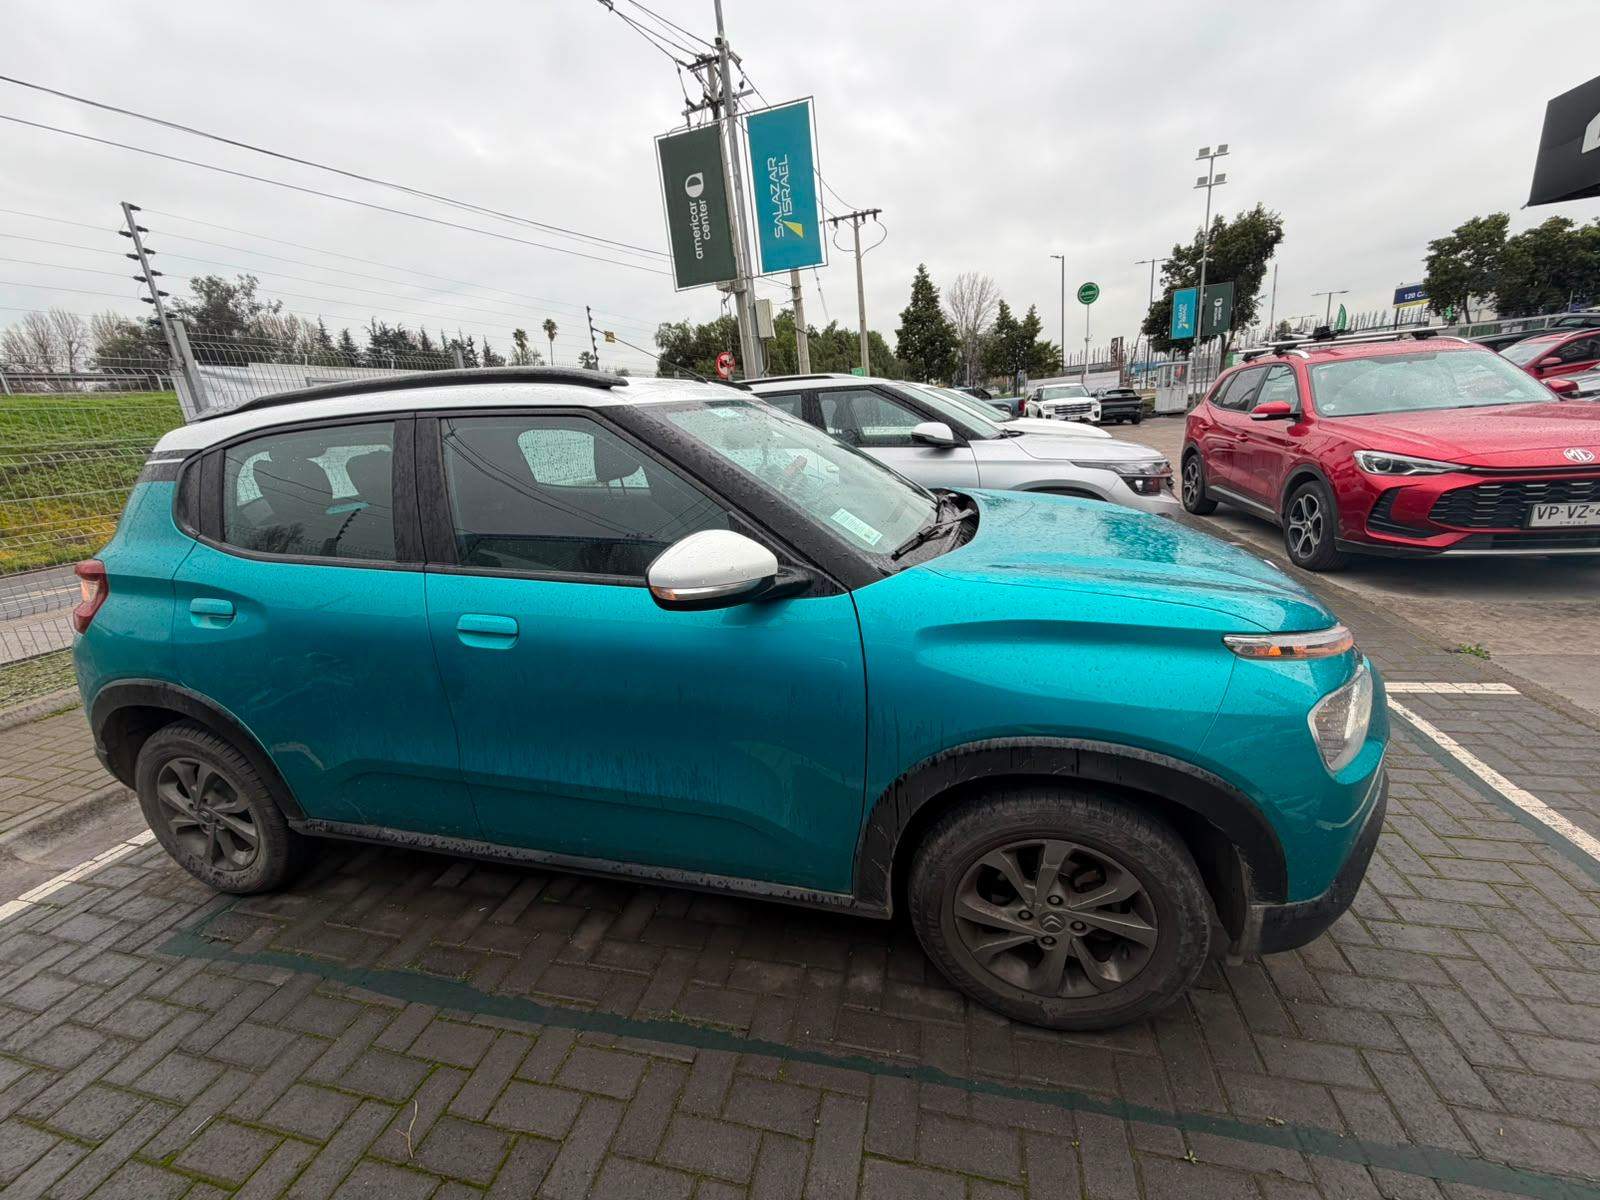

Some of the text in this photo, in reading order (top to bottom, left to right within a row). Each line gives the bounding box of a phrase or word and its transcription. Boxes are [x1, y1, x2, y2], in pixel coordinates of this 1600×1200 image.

[767, 156, 785, 239] SALAZAR
[779, 153, 793, 216] ISRAEL
[689, 201, 704, 260] americar
[698, 199, 711, 240] center
